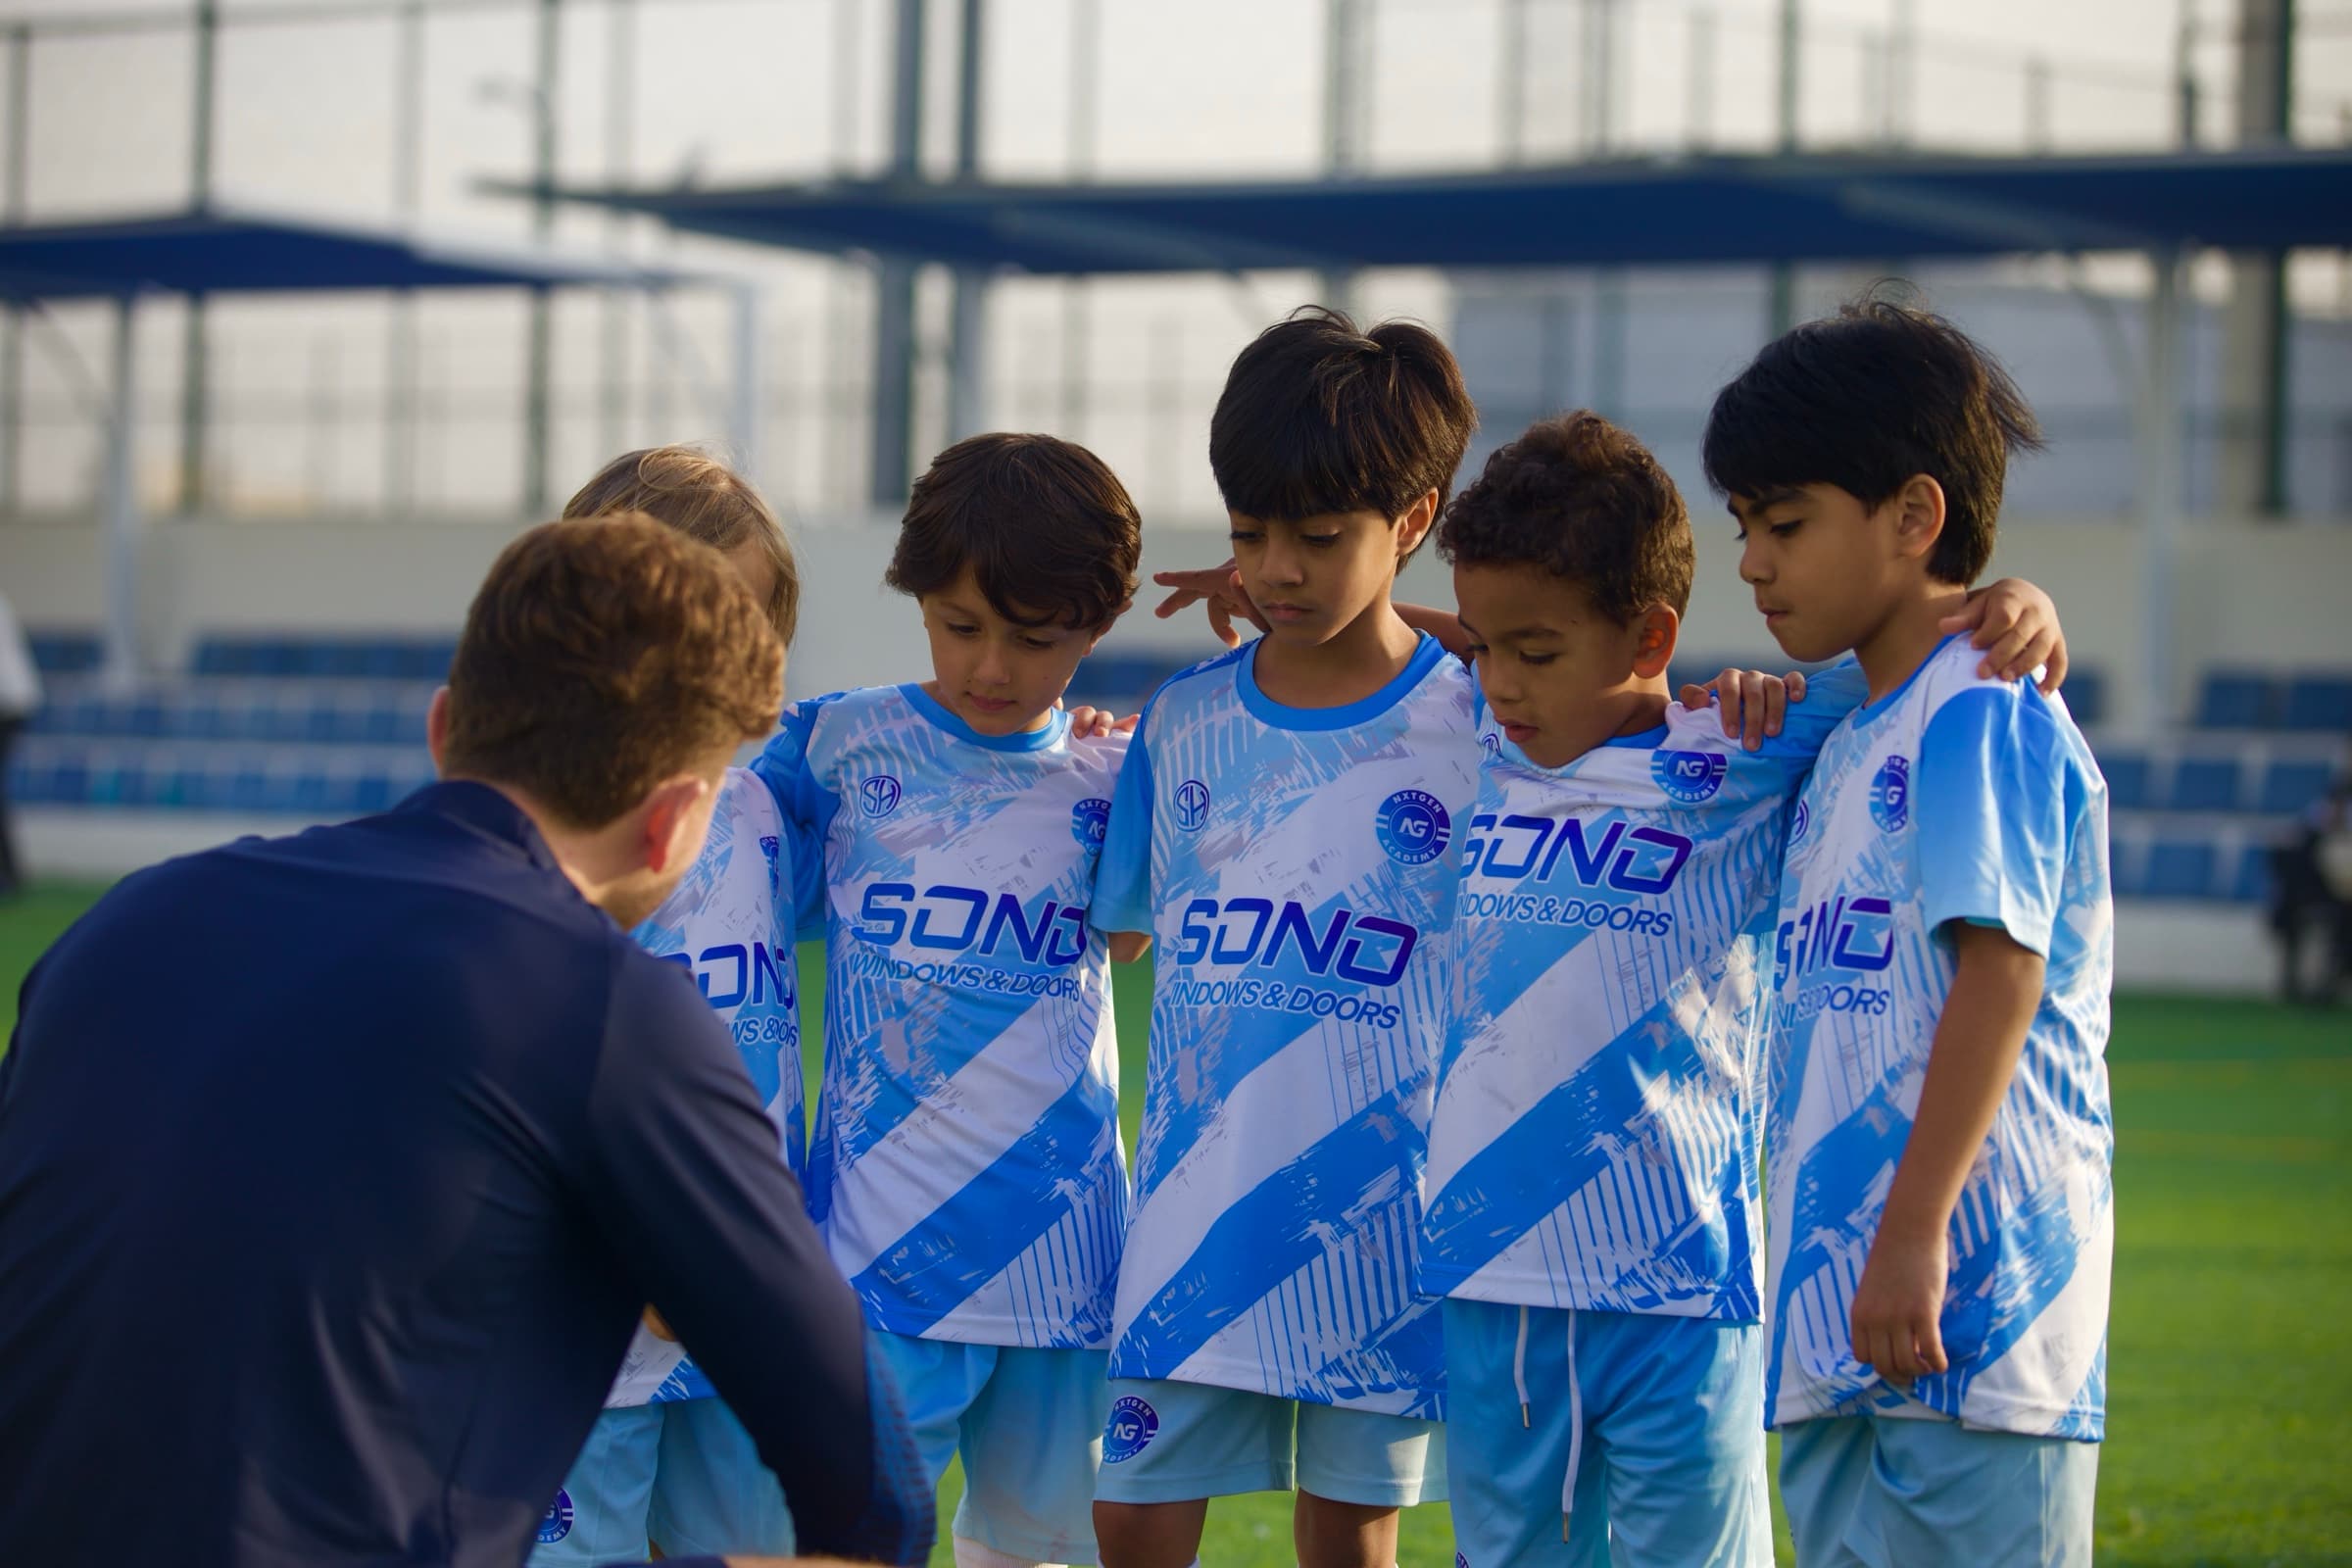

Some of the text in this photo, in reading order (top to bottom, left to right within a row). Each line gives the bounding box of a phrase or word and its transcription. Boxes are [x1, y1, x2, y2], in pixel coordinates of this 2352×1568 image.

[1393, 791, 1443, 813] NXTGEN
[1382, 839, 1436, 862] ACADEMY
[1177, 898, 1418, 988] SONO
